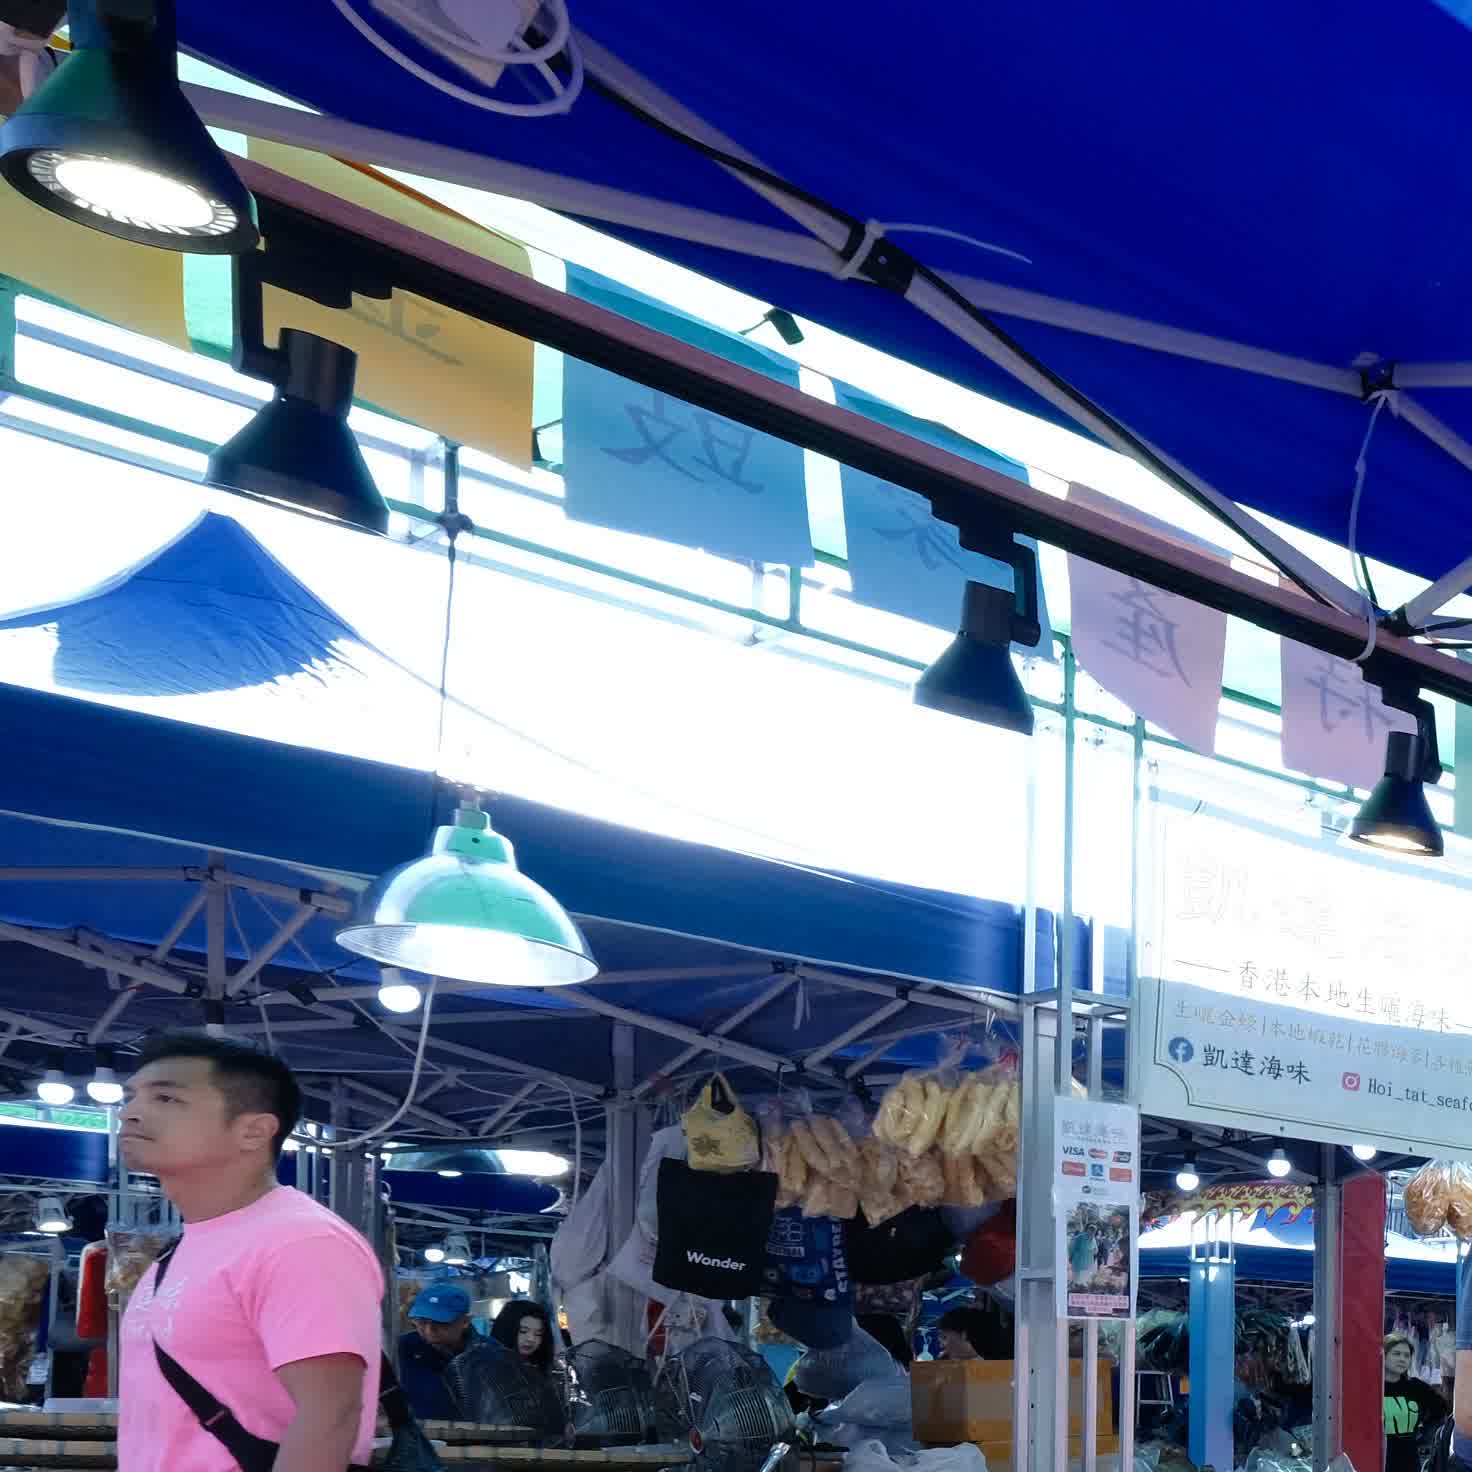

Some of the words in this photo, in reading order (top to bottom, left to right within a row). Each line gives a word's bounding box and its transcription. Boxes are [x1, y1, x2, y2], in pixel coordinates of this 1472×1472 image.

[1203, 1043, 1312, 1086] 凱達海味
[1062, 1145, 1085, 1157] VISA
[687, 1250, 746, 1271] Wonder
